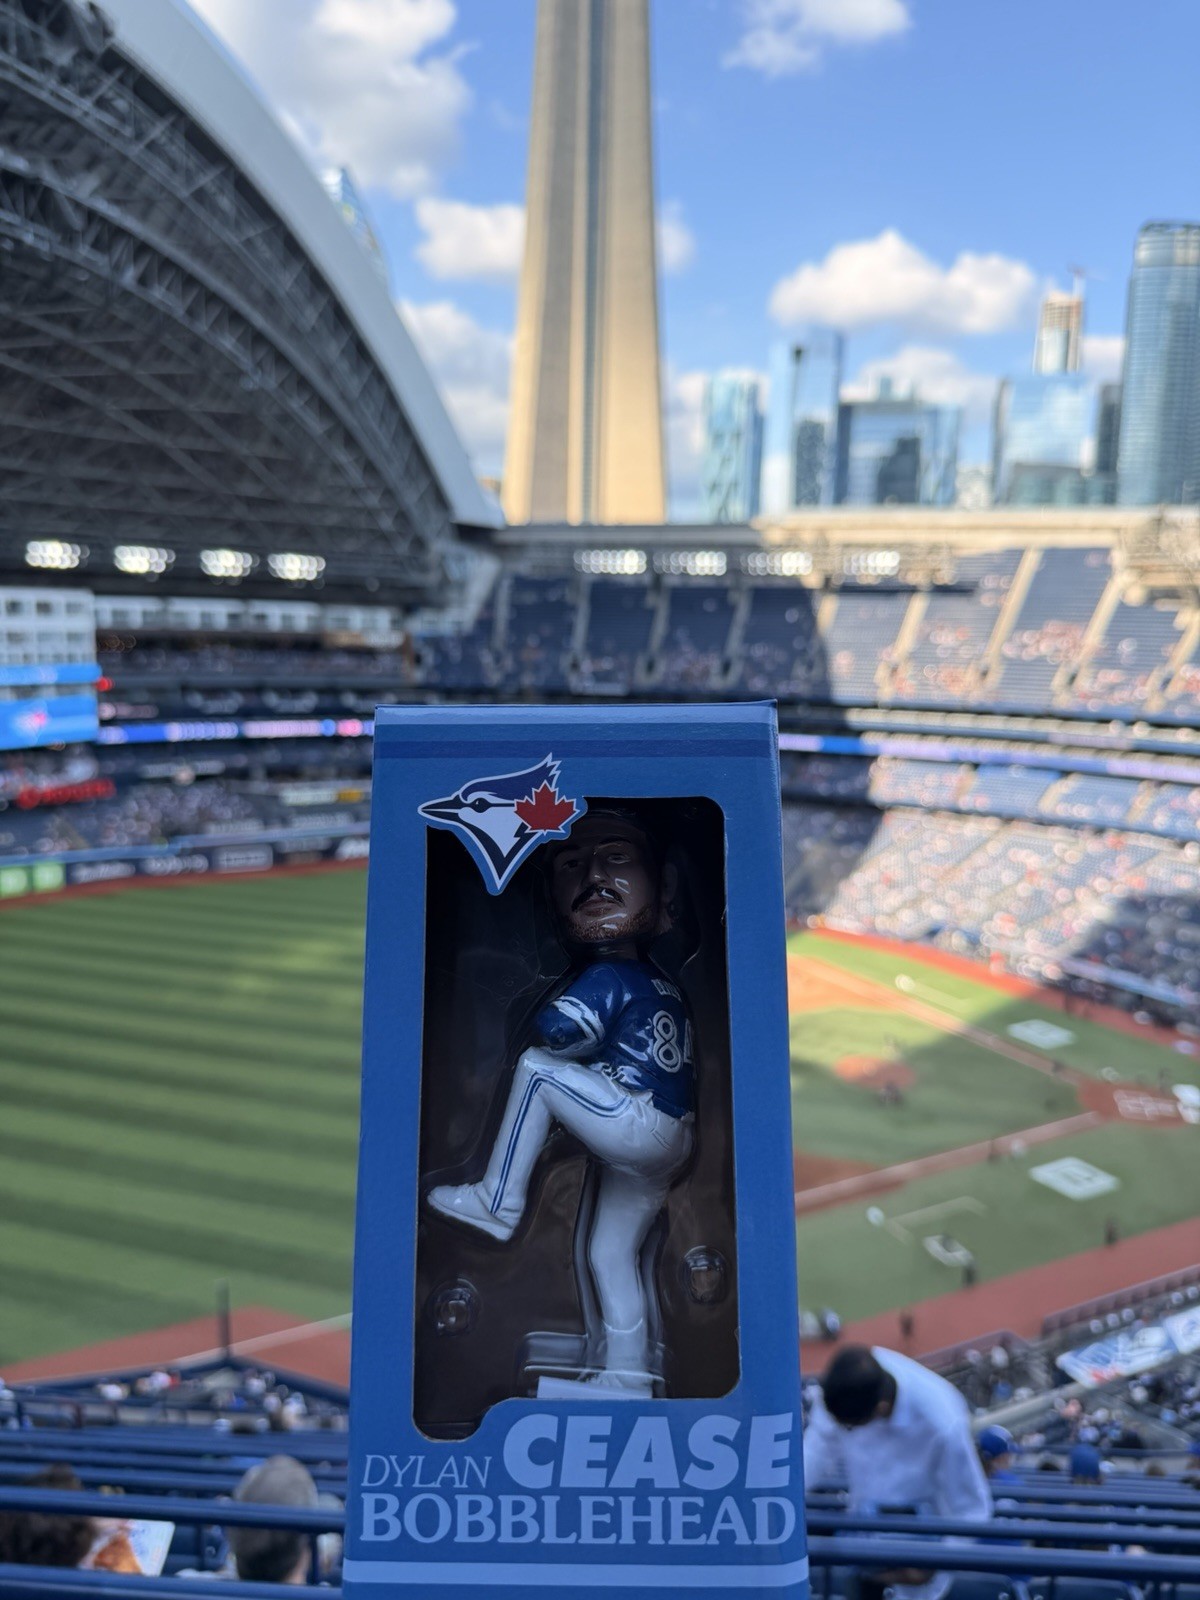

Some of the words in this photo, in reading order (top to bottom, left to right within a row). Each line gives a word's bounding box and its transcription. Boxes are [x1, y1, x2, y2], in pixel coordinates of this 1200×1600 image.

[361, 1454, 492, 1488] DYLAN
[503, 1412, 793, 1490] CEASE
[360, 1493, 796, 1545] BOBBLEHEAD
